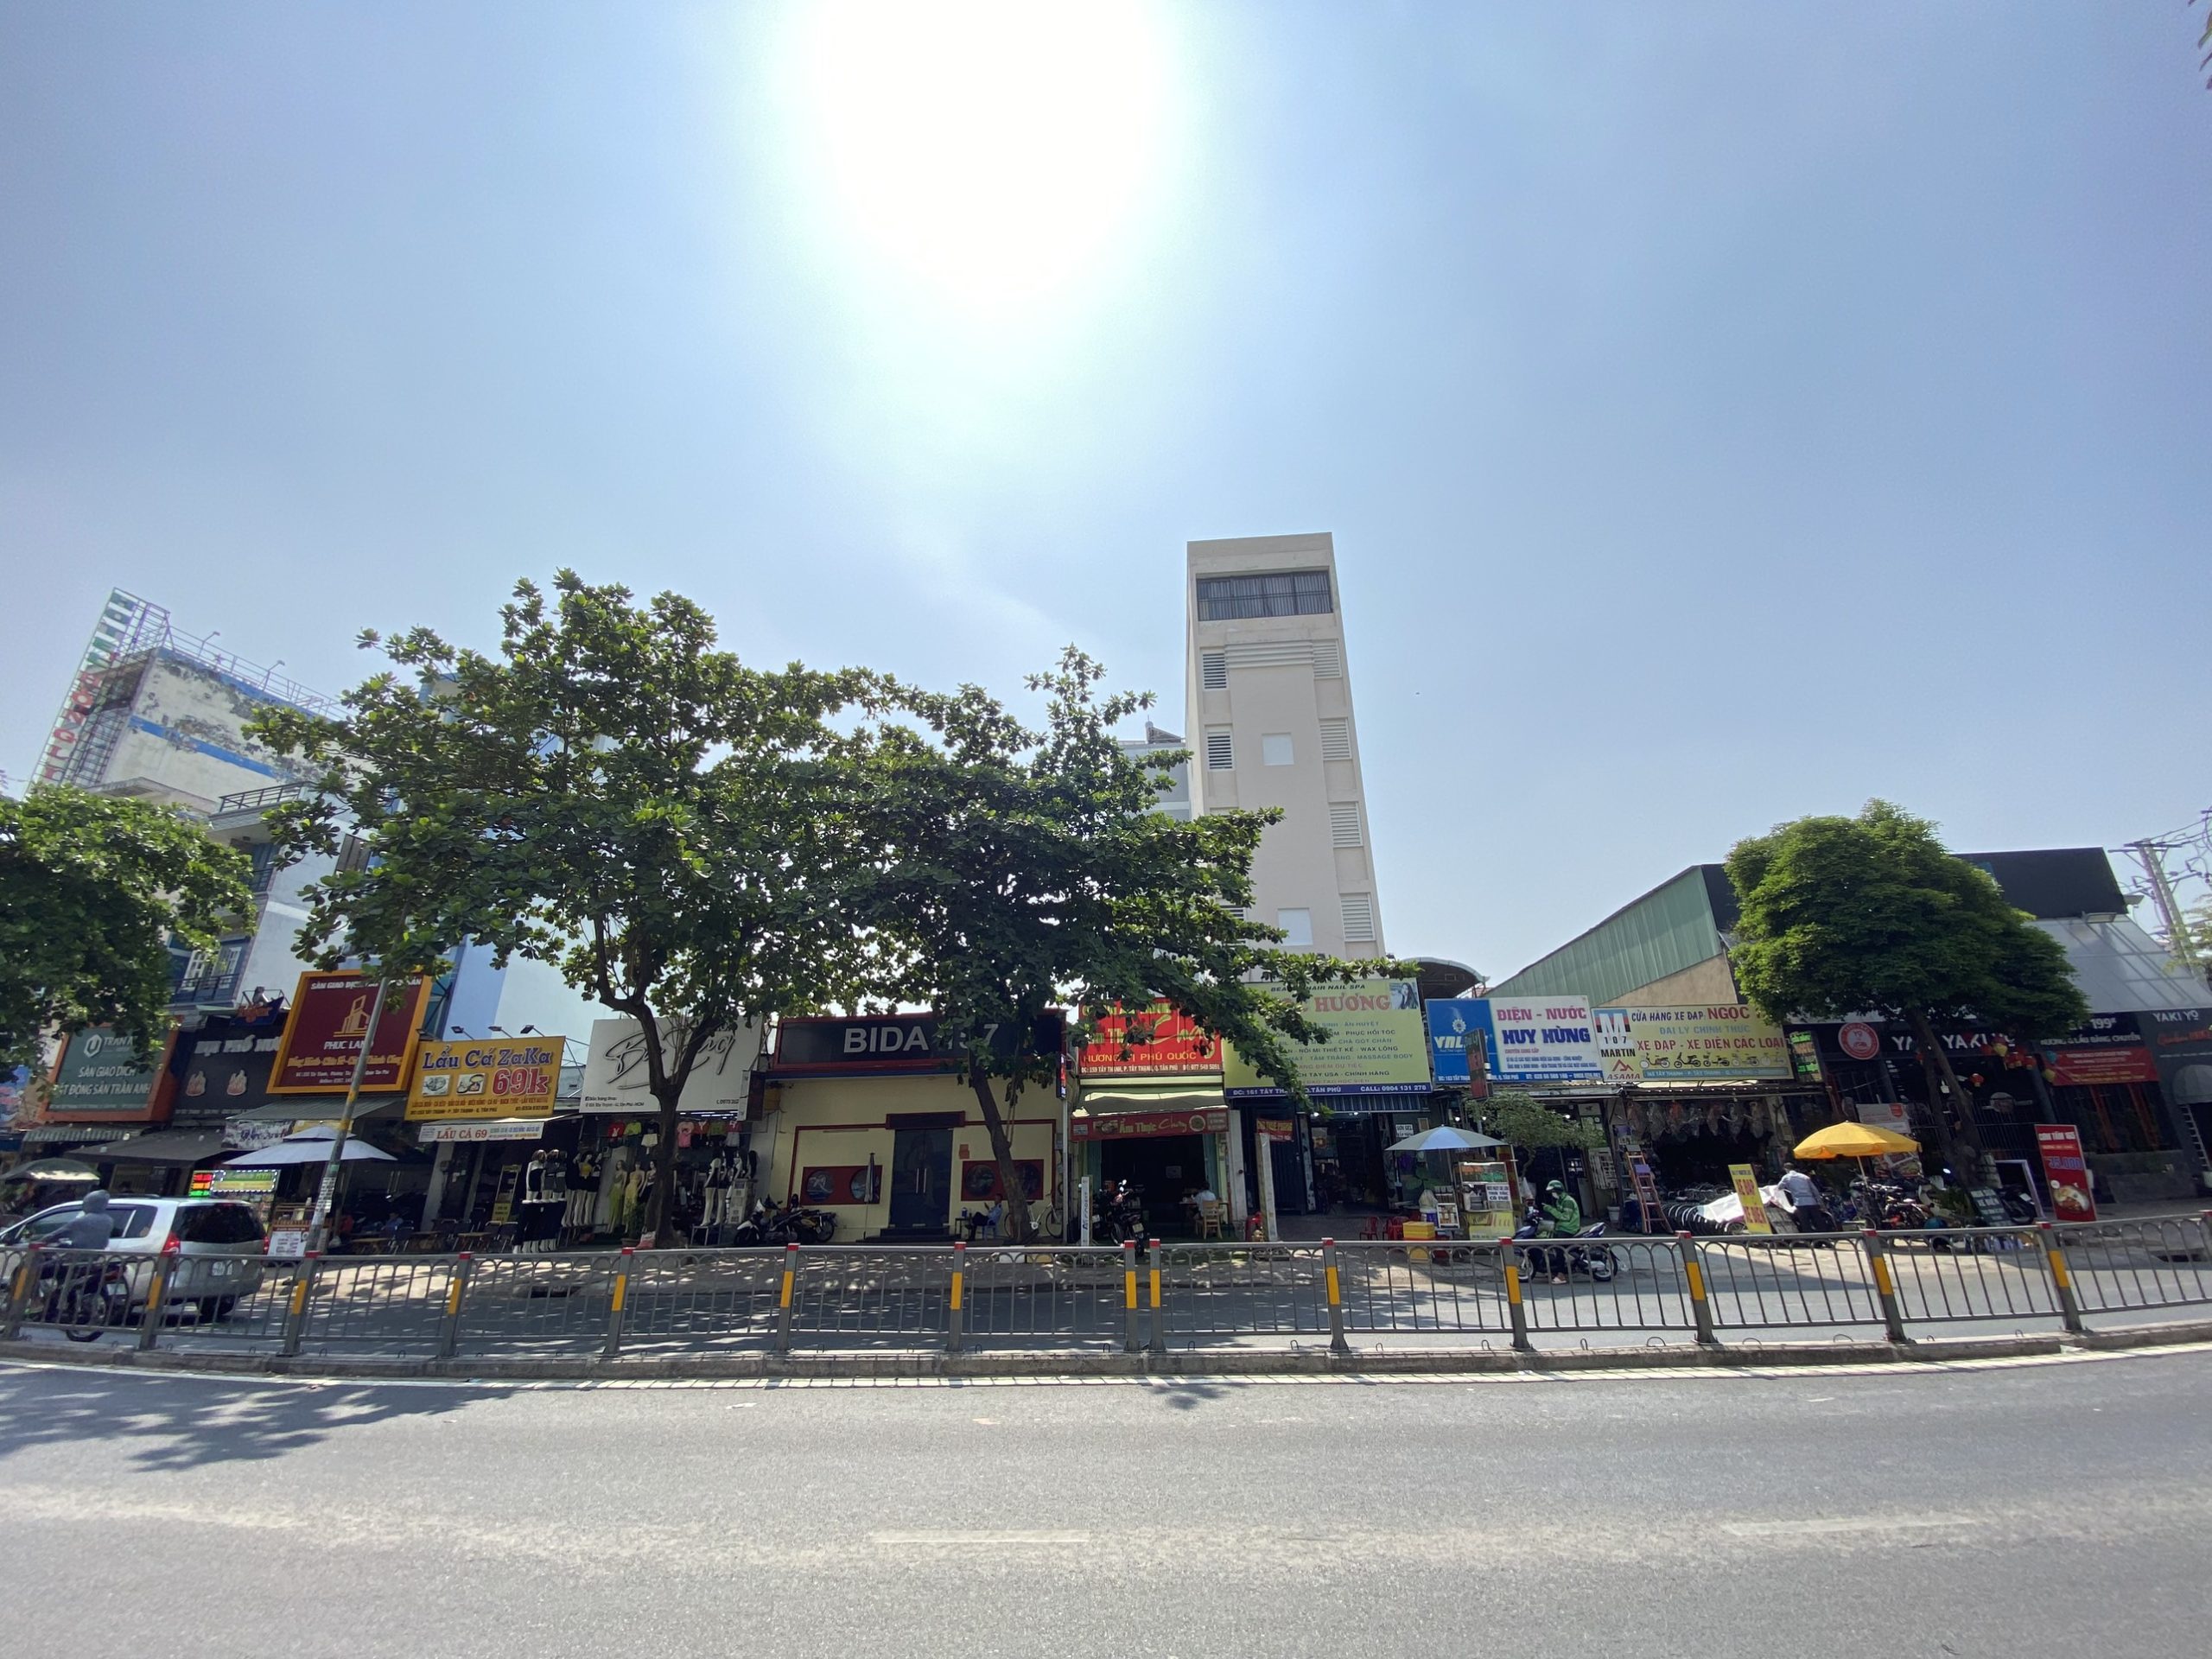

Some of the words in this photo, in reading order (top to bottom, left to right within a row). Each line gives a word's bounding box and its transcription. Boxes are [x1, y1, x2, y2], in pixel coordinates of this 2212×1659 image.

[1314, 992, 1390, 1012] HƯƠNG
[1497, 1007, 1533, 1023] ĐIỆN
[1546, 1006, 1586, 1020] NƯỚC
[1631, 1009, 1647, 1021] CỬA
[1649, 1010, 1671, 1021] HÀNG
[1675, 1012, 1685, 1020] XE
[1707, 1007, 1750, 1021] NGỌC
[2152, 1012, 2182, 1022] YAKI
[843, 1026, 929, 1052] BIDA
[1503, 1029, 1536, 1045] HUY
[1637, 1040, 1650, 1051] XE
[1654, 1039, 1676, 1052] ĐẠP
[1687, 1039, 1701, 1050] XE
[1704, 1036, 1732, 1051] ĐIỆN
[1759, 1038, 1784, 1051] LOẠI
[423, 1044, 460, 1071] Lẩu
[465, 1046, 495, 1068] Cá
[498, 1046, 553, 1067] ZaKa
[1141, 1051, 1163, 1060] PHÚ
[1166, 1049, 1197, 1060] QUỐC
[1600, 1048, 1636, 1058] MARTIN
[132, 1084, 152, 1095] ANH
[493, 1067, 550, 1096] 69k
[437, 1128, 456, 1140] LẨU
[460, 1127, 473, 1139] CÁ
[474, 1129, 487, 1139] 69
